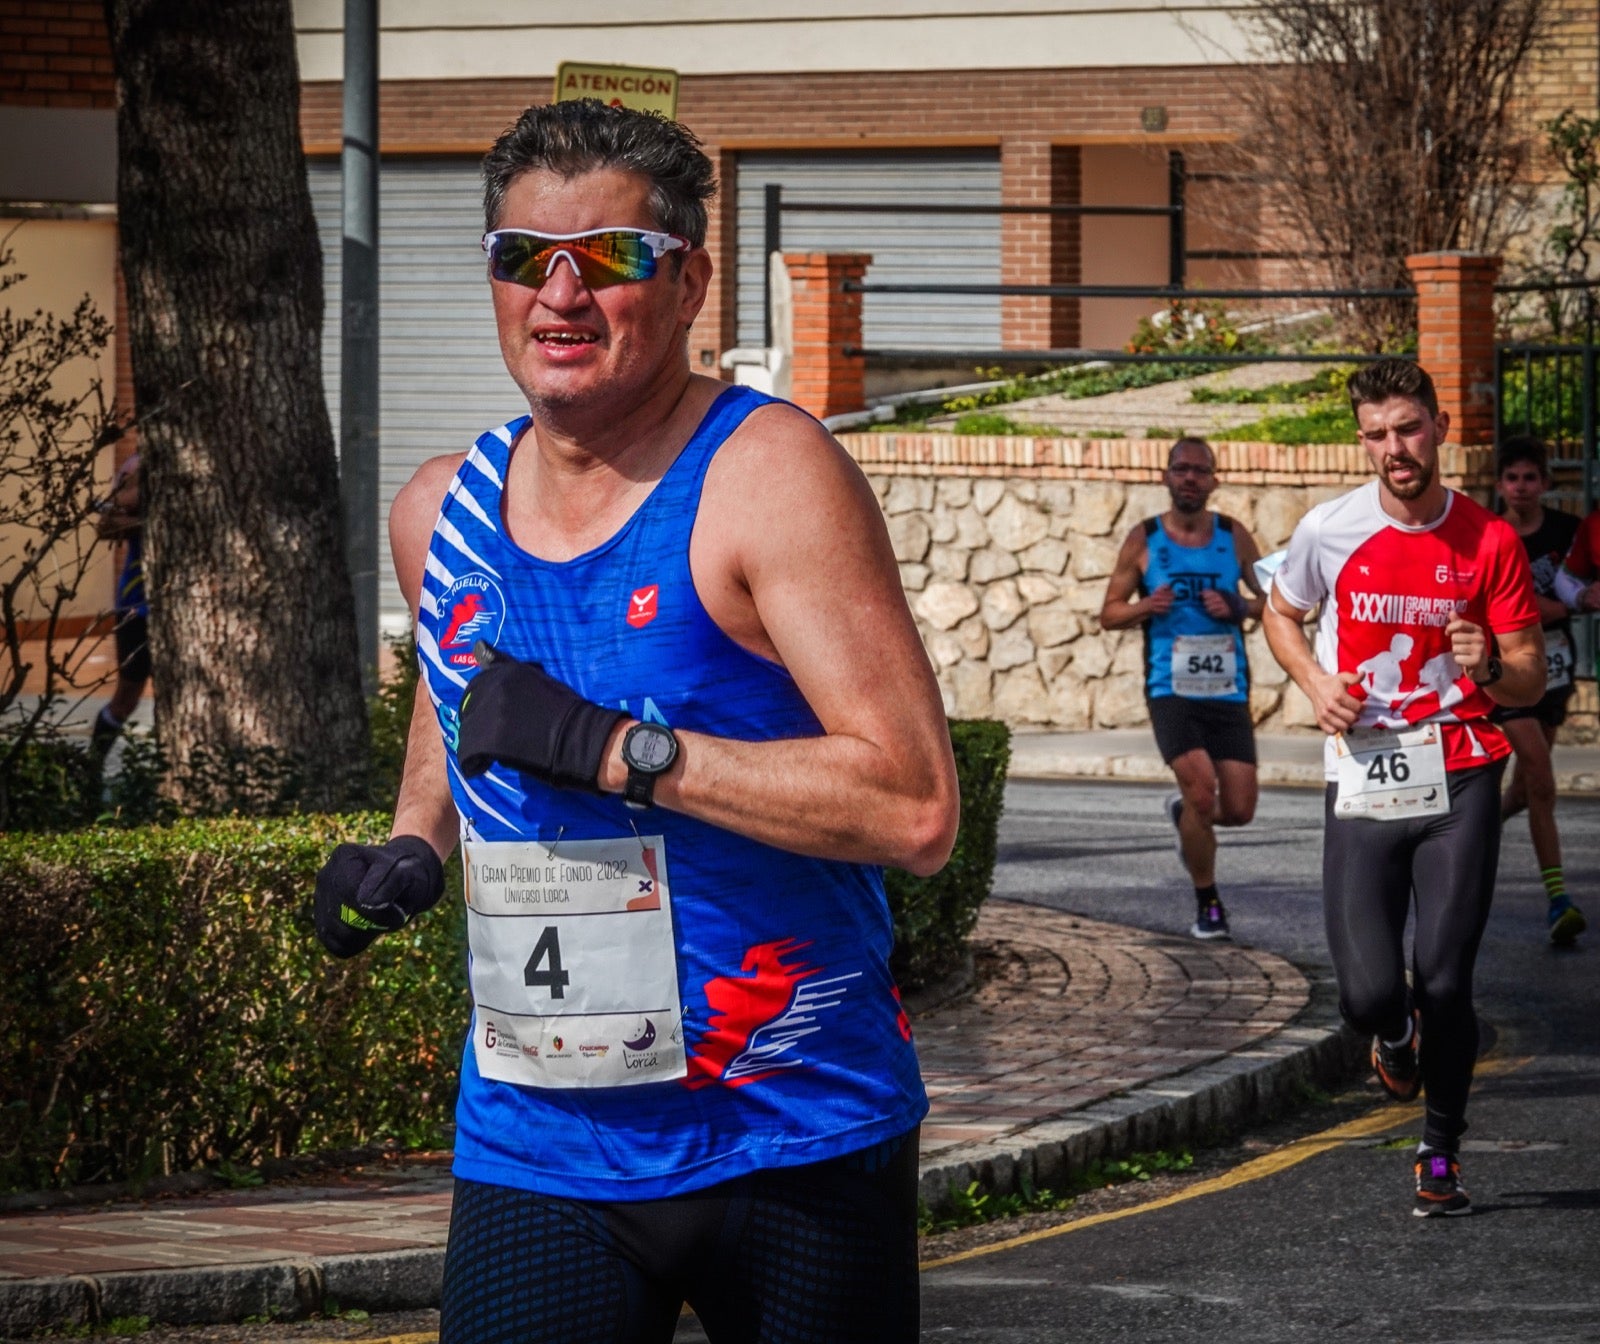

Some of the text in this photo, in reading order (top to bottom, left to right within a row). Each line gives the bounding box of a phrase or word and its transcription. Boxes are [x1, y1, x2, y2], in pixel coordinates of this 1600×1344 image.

[565, 73, 671, 95] ATENCIÓN
[451, 577, 490, 597] HUELLAS
[1349, 591, 1405, 625] XXXIII
[1404, 596, 1432, 612] GRAN
[1404, 611, 1417, 625] DE
[453, 654, 467, 664] LAS
[1188, 655, 1225, 674] 542
[1367, 752, 1410, 784] 46
[482, 863, 507, 884] GRAN
[510, 863, 541, 883] PREMIO
[545, 866, 556, 883] DE
[560, 863, 592, 882] FONDO
[596, 859, 629, 881] 2022
[504, 888, 570, 904] UNIVERSO LORCA
[523, 926, 570, 1000] 4
[623, 1049, 659, 1069] Lorca
